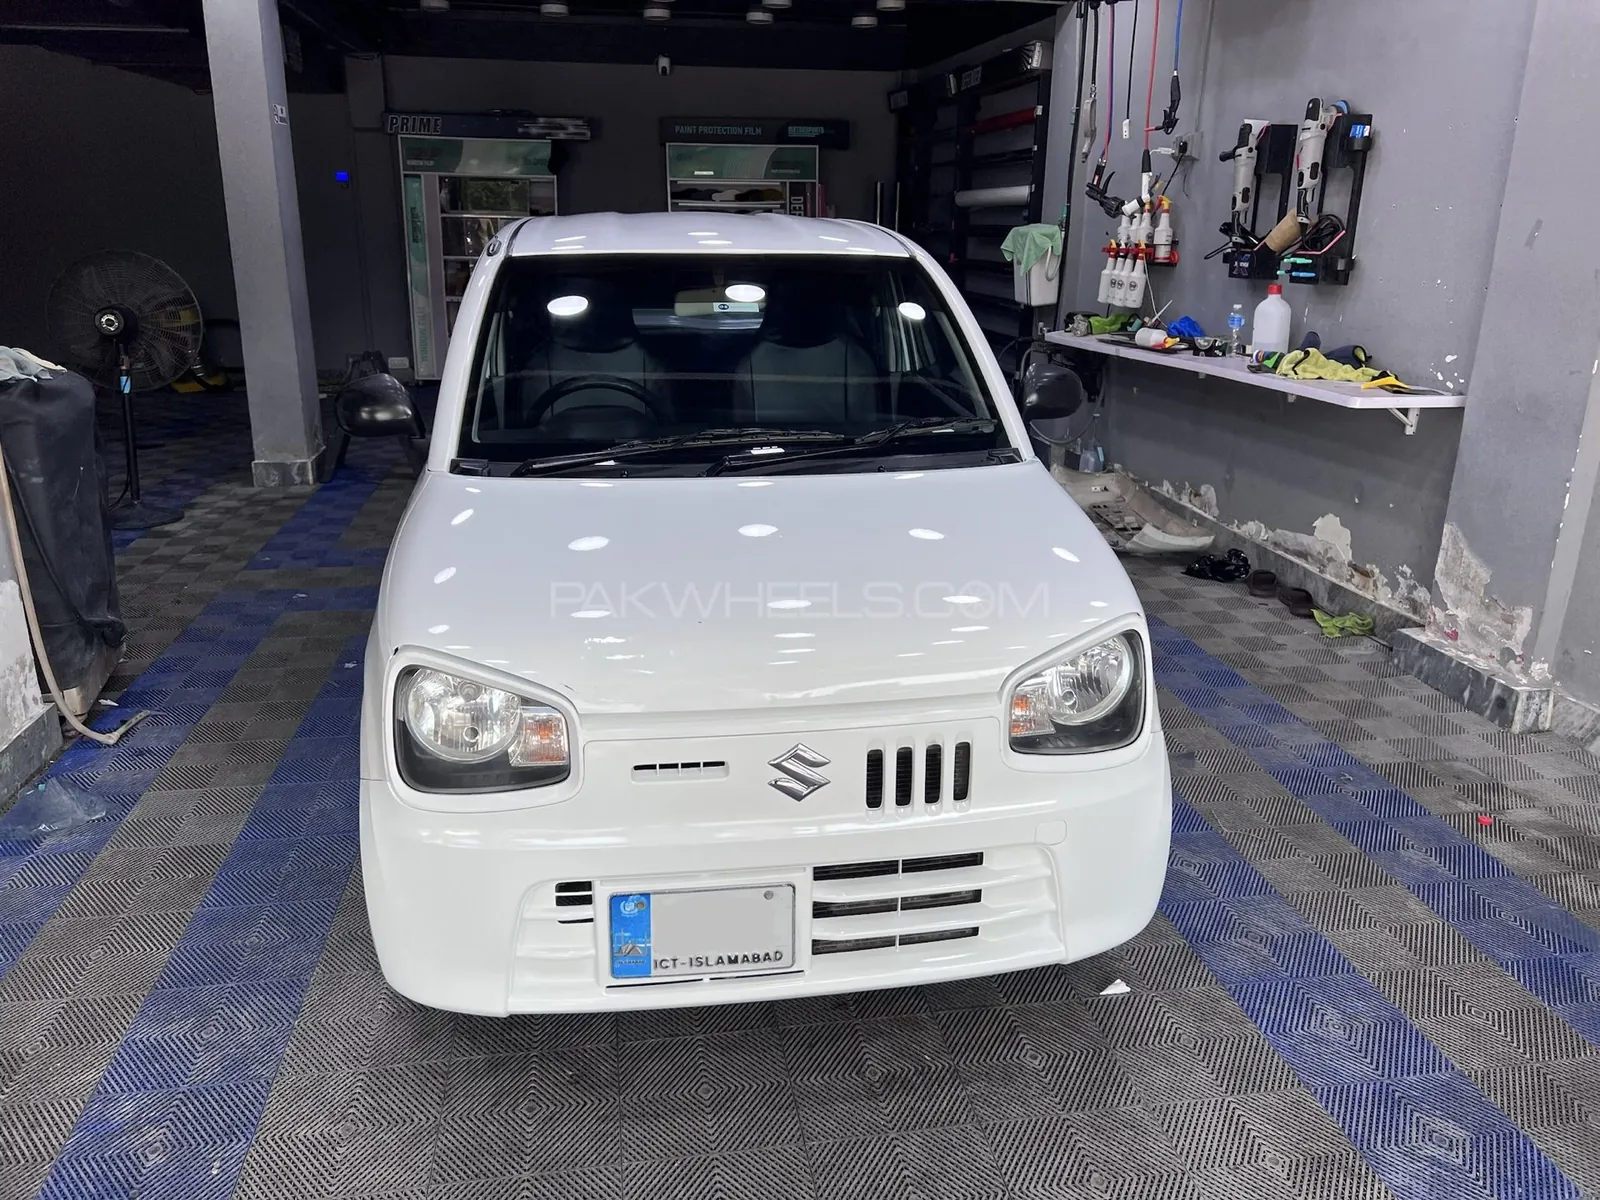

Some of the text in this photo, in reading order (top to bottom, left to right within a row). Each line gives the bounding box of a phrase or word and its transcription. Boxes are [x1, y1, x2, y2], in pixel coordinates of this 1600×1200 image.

[388, 115, 442, 134] PRIME
[675, 125, 762, 136] PAINT PROTECTION FILM
[418, 328, 428, 363] WINDOW
[653, 950, 784, 970] ICT-ISLAMABAD
